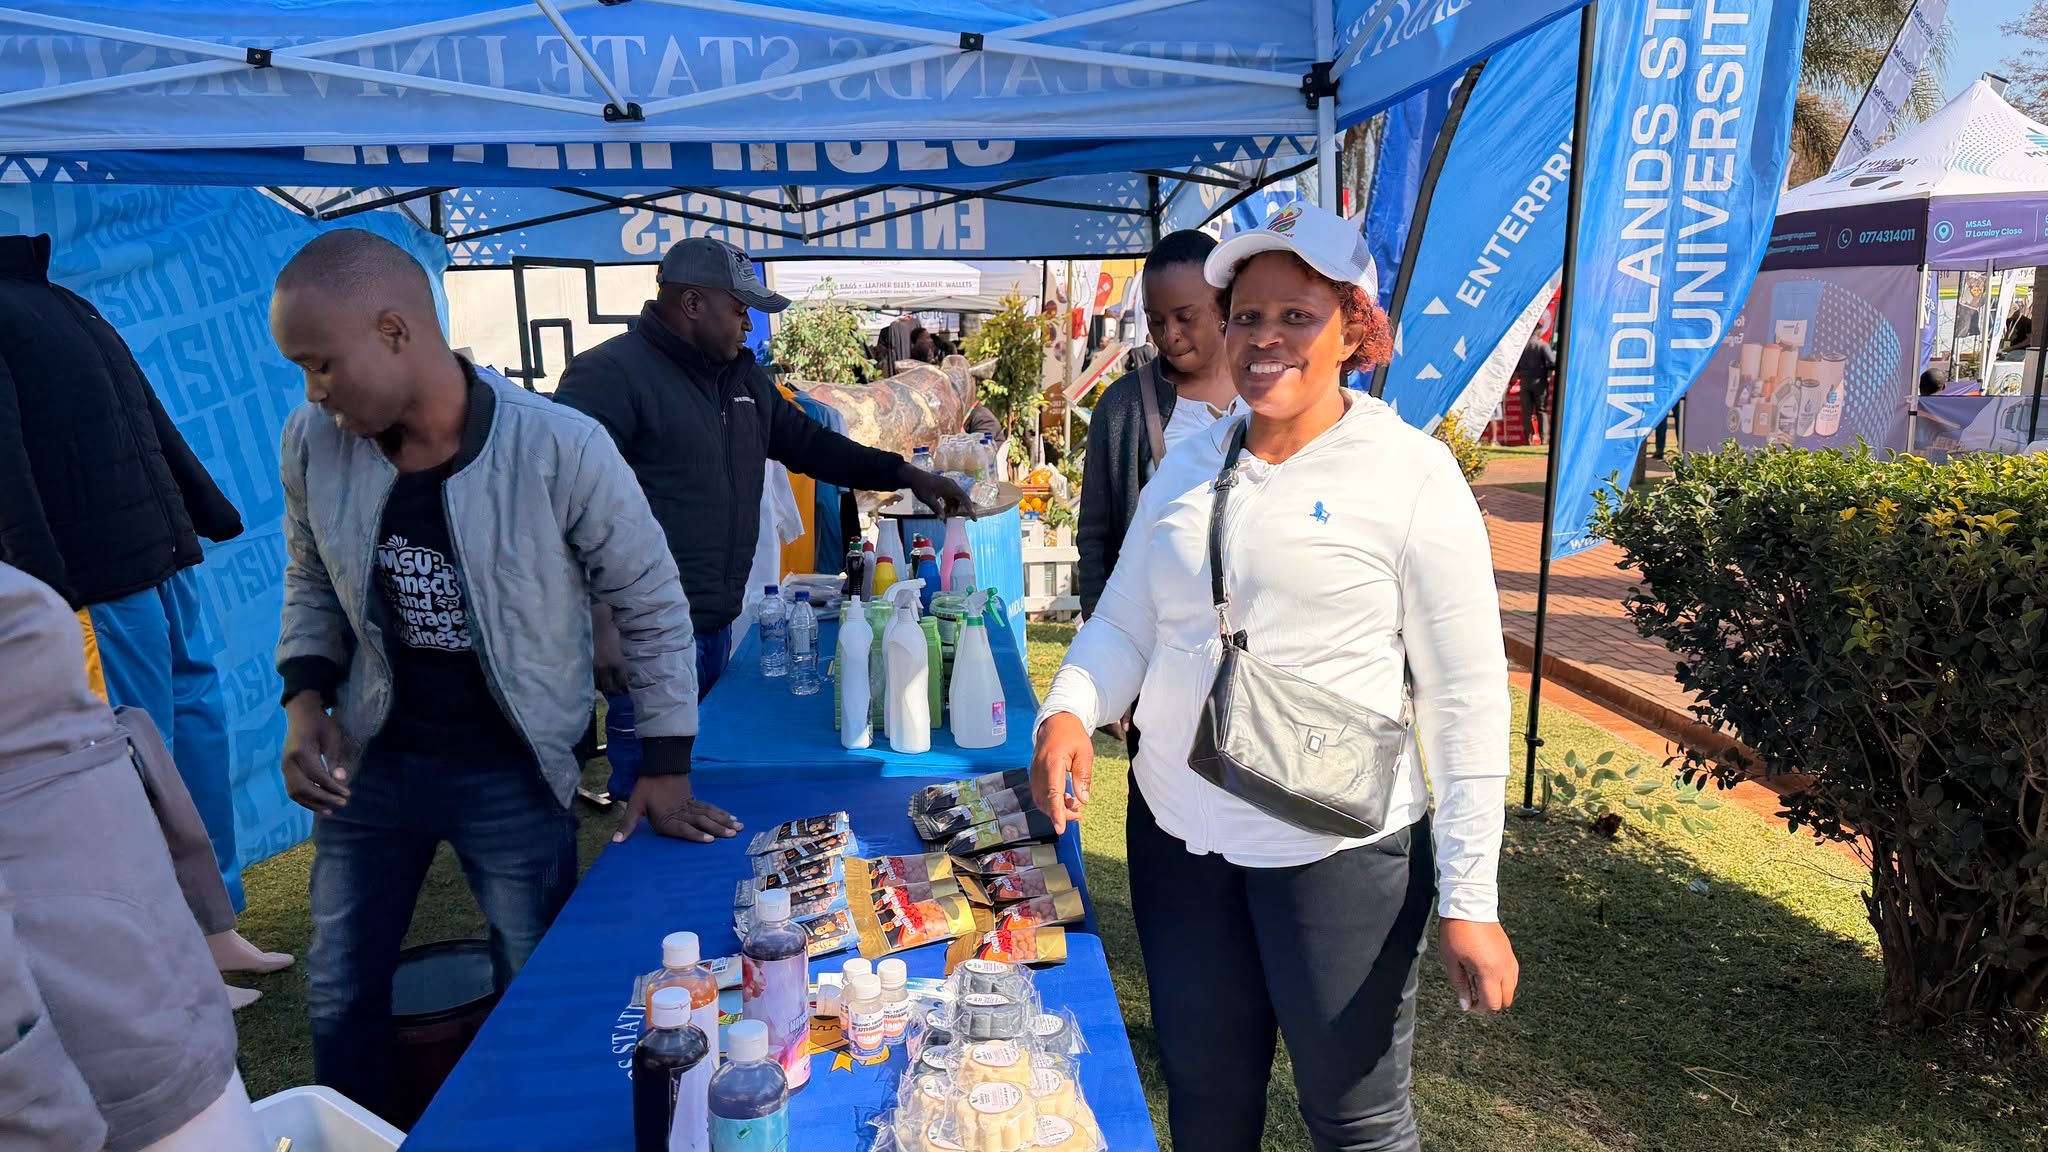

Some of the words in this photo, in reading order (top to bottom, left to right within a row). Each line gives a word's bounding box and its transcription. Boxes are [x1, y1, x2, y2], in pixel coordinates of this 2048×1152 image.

[1456, 128, 1574, 308] ENTERPRI
[1965, 219, 1992, 228] MSASA
[1859, 228, 1915, 244] 0774314011
[865, 281, 892, 289] LEATHER
[945, 281, 973, 289] WALLETS
[1604, 103, 1679, 440] MIDLANDS
[379, 549, 441, 576] MSU:
[392, 568, 455, 597] nnect
[399, 593, 432, 611] and
[611, 1003, 646, 1056] STAT
